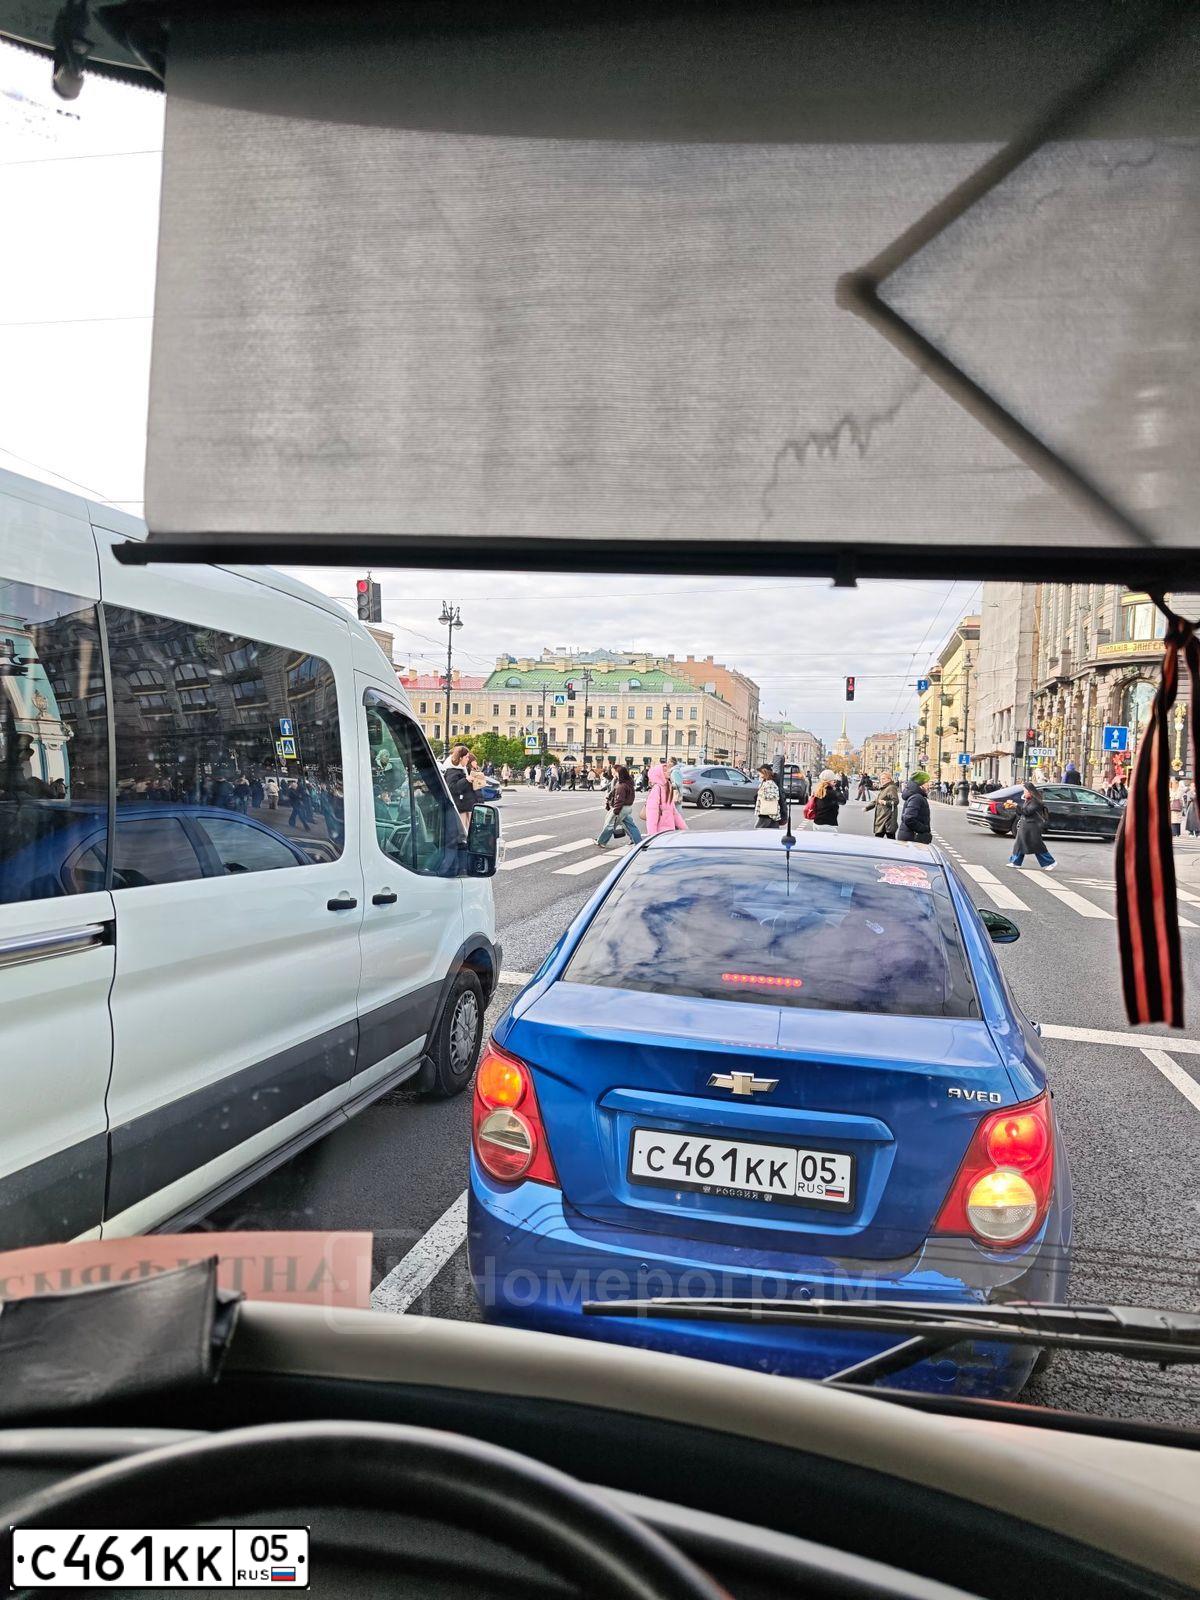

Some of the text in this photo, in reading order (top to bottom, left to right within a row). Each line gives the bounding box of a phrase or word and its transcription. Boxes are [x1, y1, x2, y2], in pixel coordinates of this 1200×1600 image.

[1032, 748, 1053, 756] СТОП
[948, 1087, 1002, 1104] AVEO
[646, 1141, 837, 1190] С461КК 05
[797, 1181, 824, 1195] RUS
